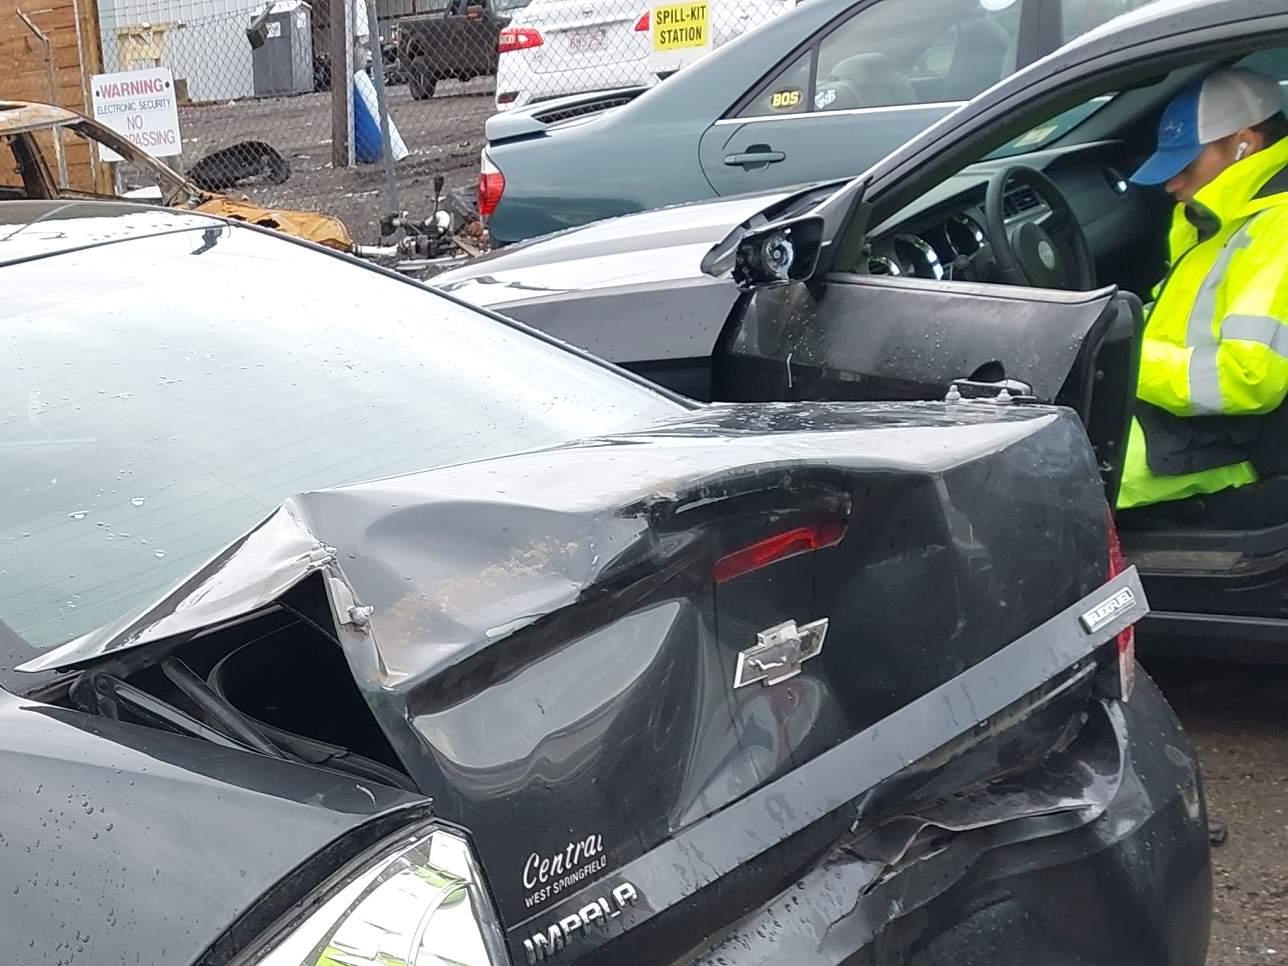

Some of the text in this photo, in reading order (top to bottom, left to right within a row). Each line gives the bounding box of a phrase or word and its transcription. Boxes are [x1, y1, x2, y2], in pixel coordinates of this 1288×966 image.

[656, 5, 706, 25] SPILL-KIT
[660, 26, 702, 45] STATION
[100, 78, 164, 99] WARNING
[97, 97, 171, 115] ELECTRONIC SECURITY
[126, 115, 144, 130] NO
[123, 129, 176, 147] PASSING
[523, 834, 604, 889] Central
[524, 854, 607, 908] WEST SPRINGFIELD
[523, 882, 638, 966] IMPALA
